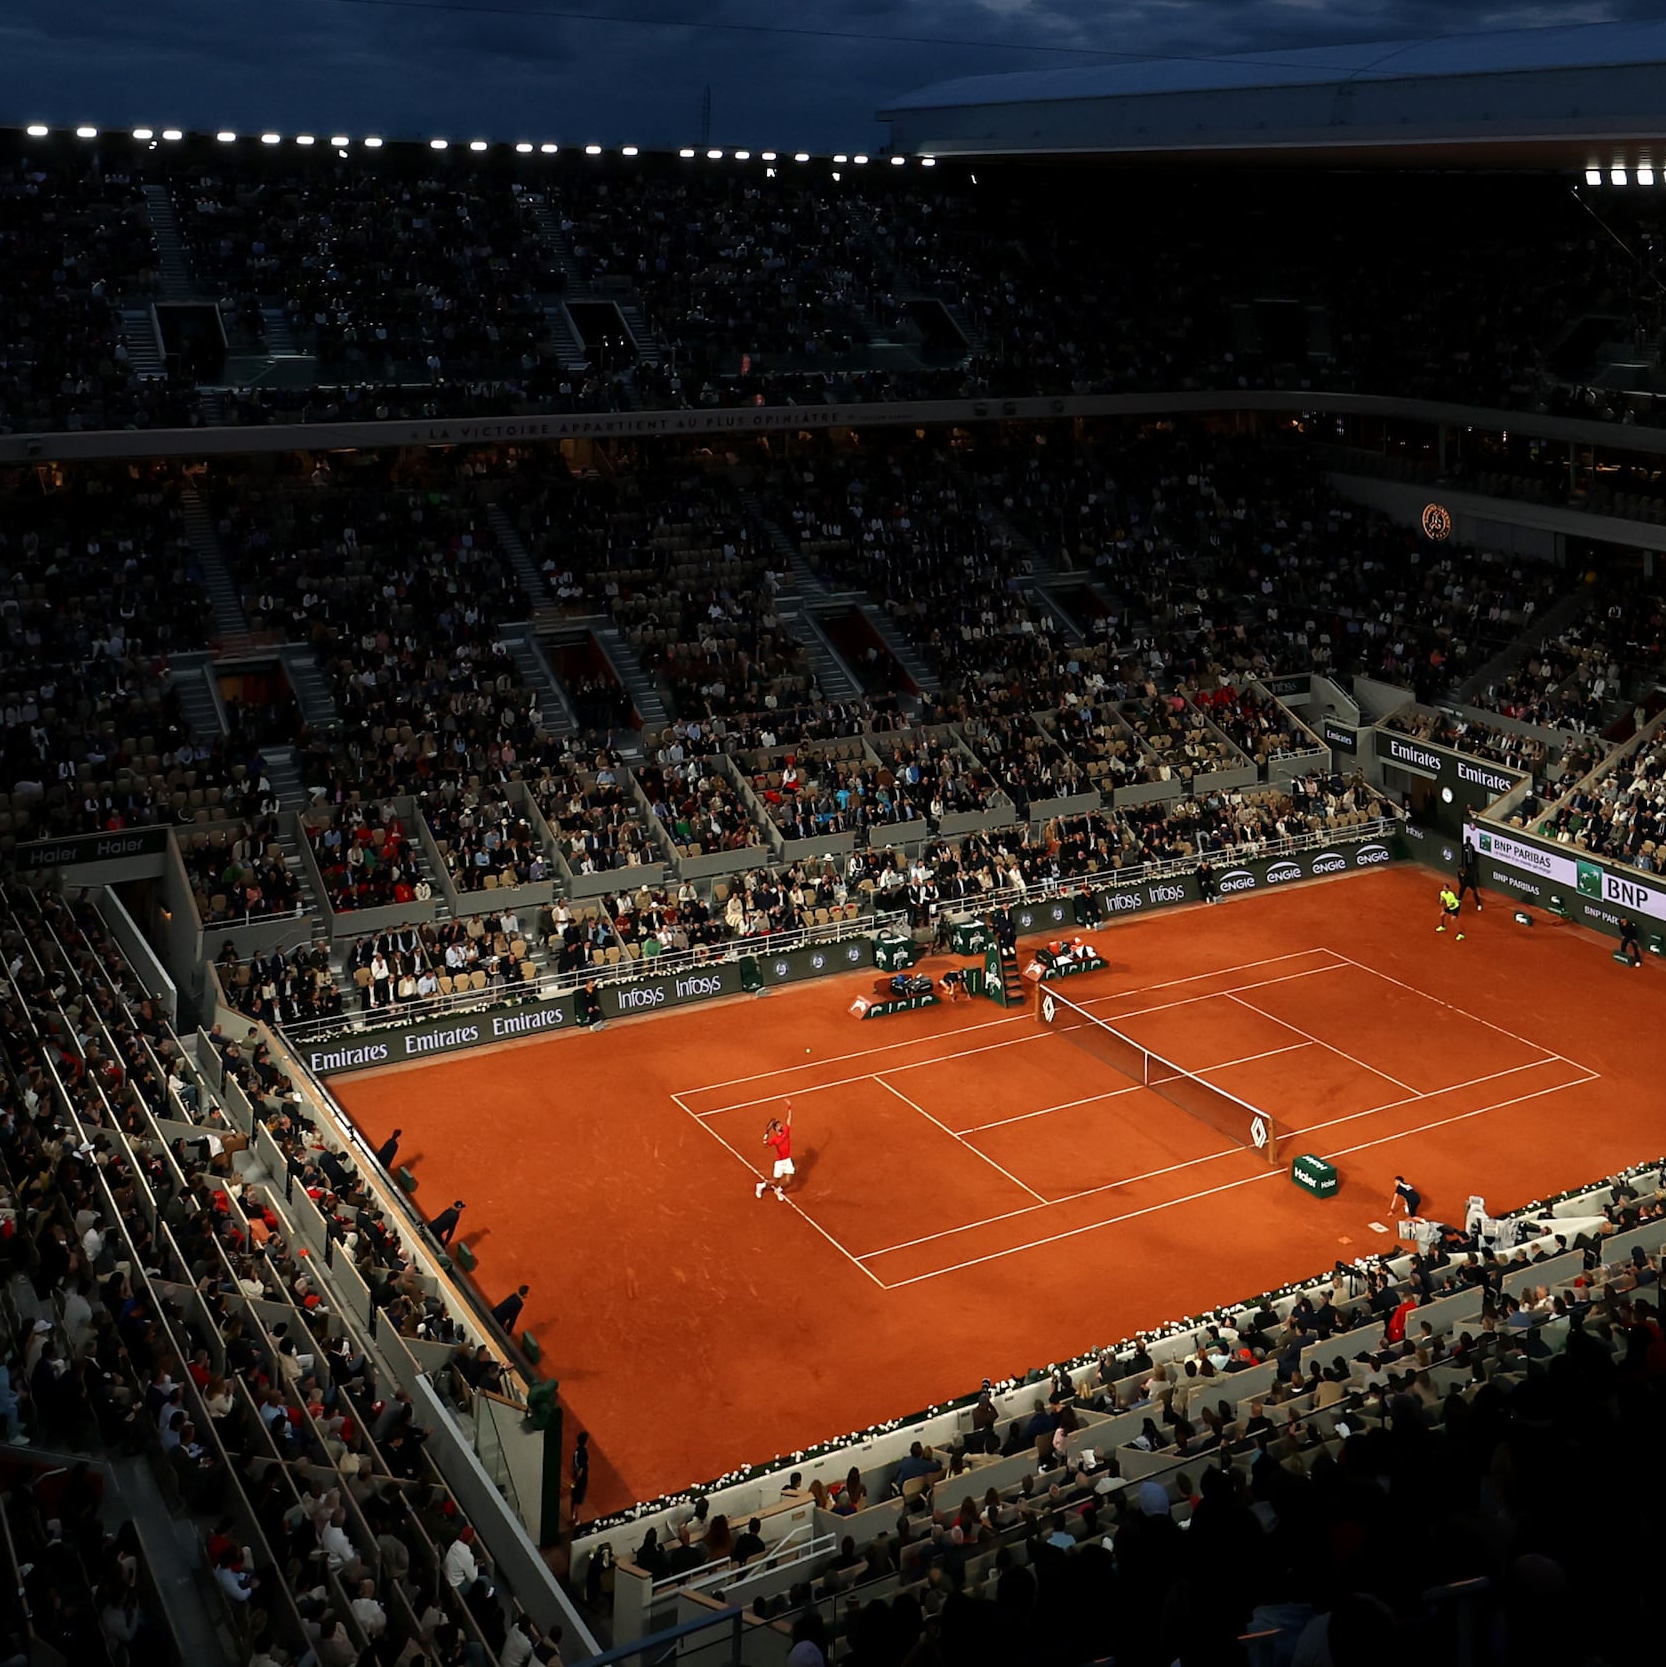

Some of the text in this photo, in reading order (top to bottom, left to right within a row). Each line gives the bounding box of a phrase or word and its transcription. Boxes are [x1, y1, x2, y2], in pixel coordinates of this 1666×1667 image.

[461, 423, 548, 437] VICTOIRE
[560, 419, 667, 433] APPARTIENT
[707, 415, 743, 427] PLUS
[1391, 741, 1512, 792] Emirates Emirates
[1494, 839, 1512, 854] BNP
[1514, 846, 1551, 868] PARIBAS
[1493, 871, 1540, 895] BNP PARIBAS
[1607, 878, 1648, 908] BNP
[1106, 885, 1184, 912] Infosys Infosys
[1584, 906, 1601, 918] BNP
[618, 975, 721, 1010] Infosys Infosys
[311, 1008, 563, 1072] Emirates Emirates Emirates
